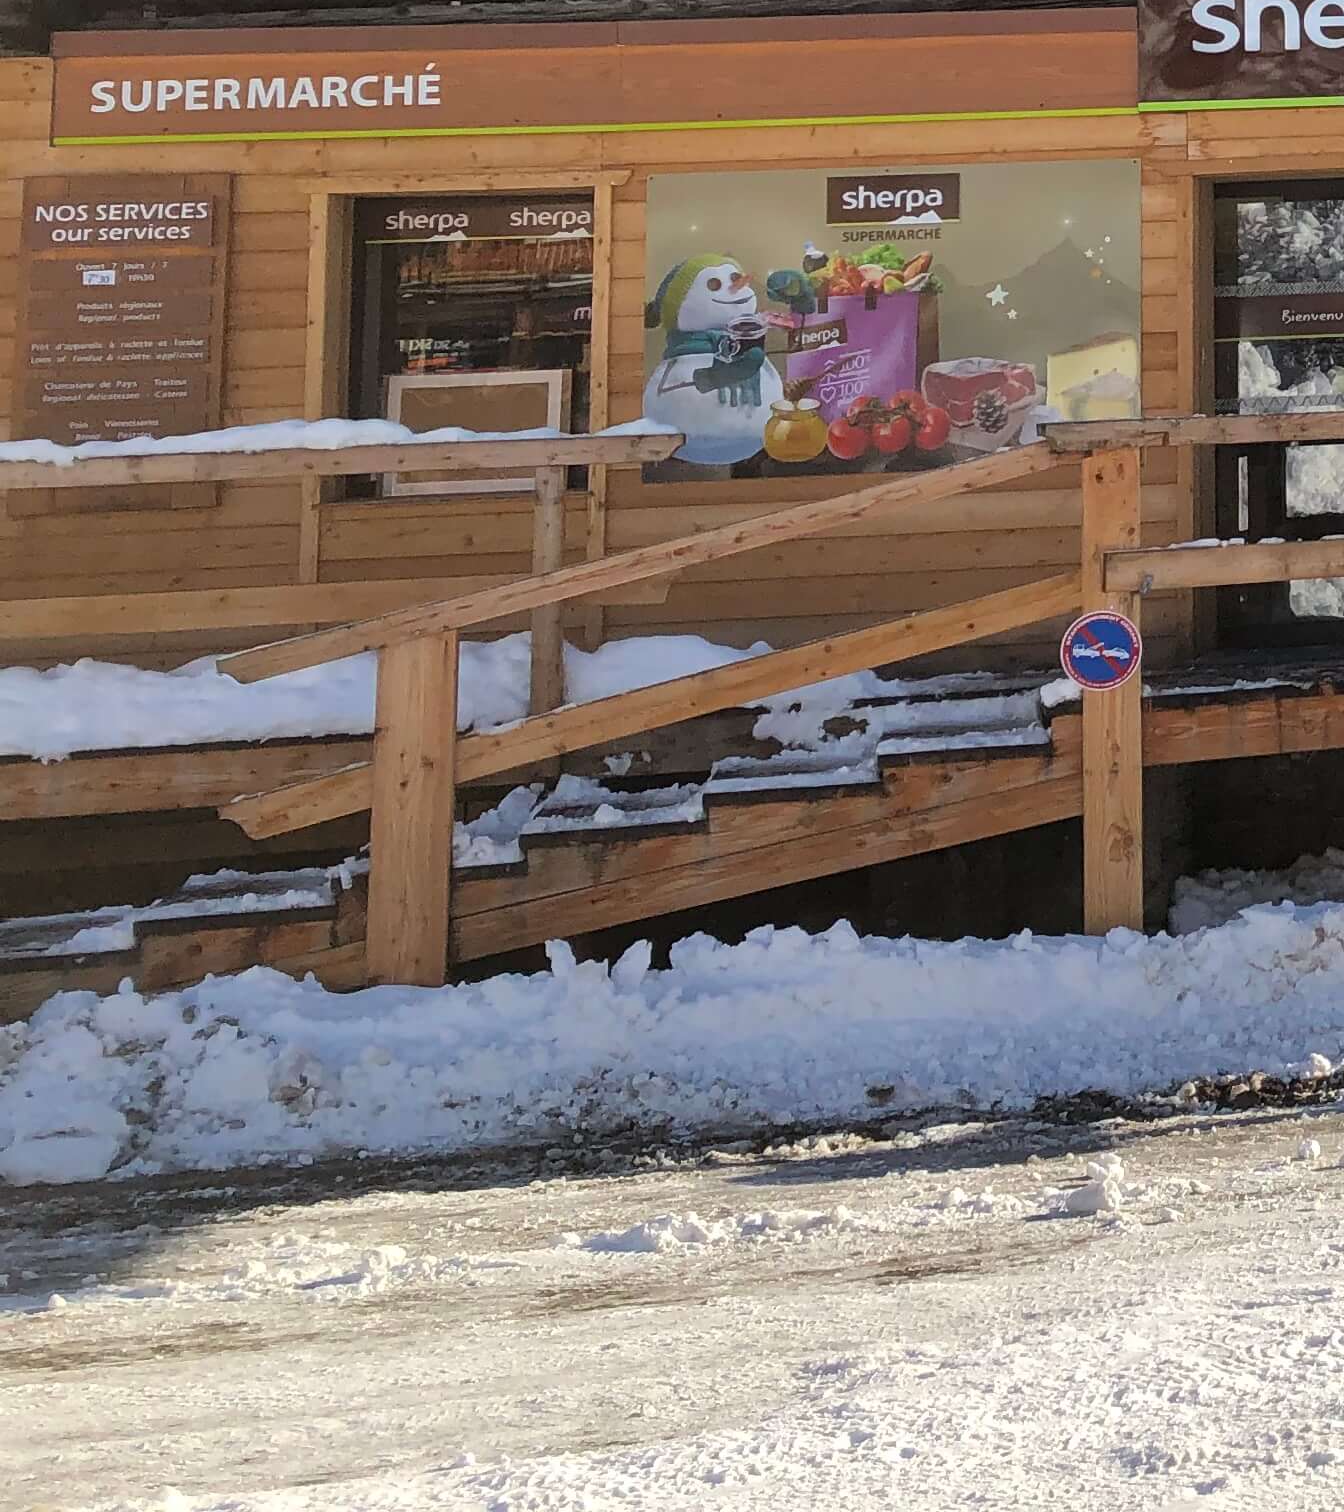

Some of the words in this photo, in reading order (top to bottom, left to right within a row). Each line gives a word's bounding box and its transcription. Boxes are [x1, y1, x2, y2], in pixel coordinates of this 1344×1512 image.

[90, 63, 442, 114] SUPERMARCHÉ
[842, 185, 943, 212] sherpa
[35, 204, 88, 222] NOS
[95, 202, 208, 221] SERVICES
[385, 211, 469, 232] sherpa
[510, 207, 591, 229] sherpa
[51, 228, 94, 242] our
[97, 224, 191, 241] services
